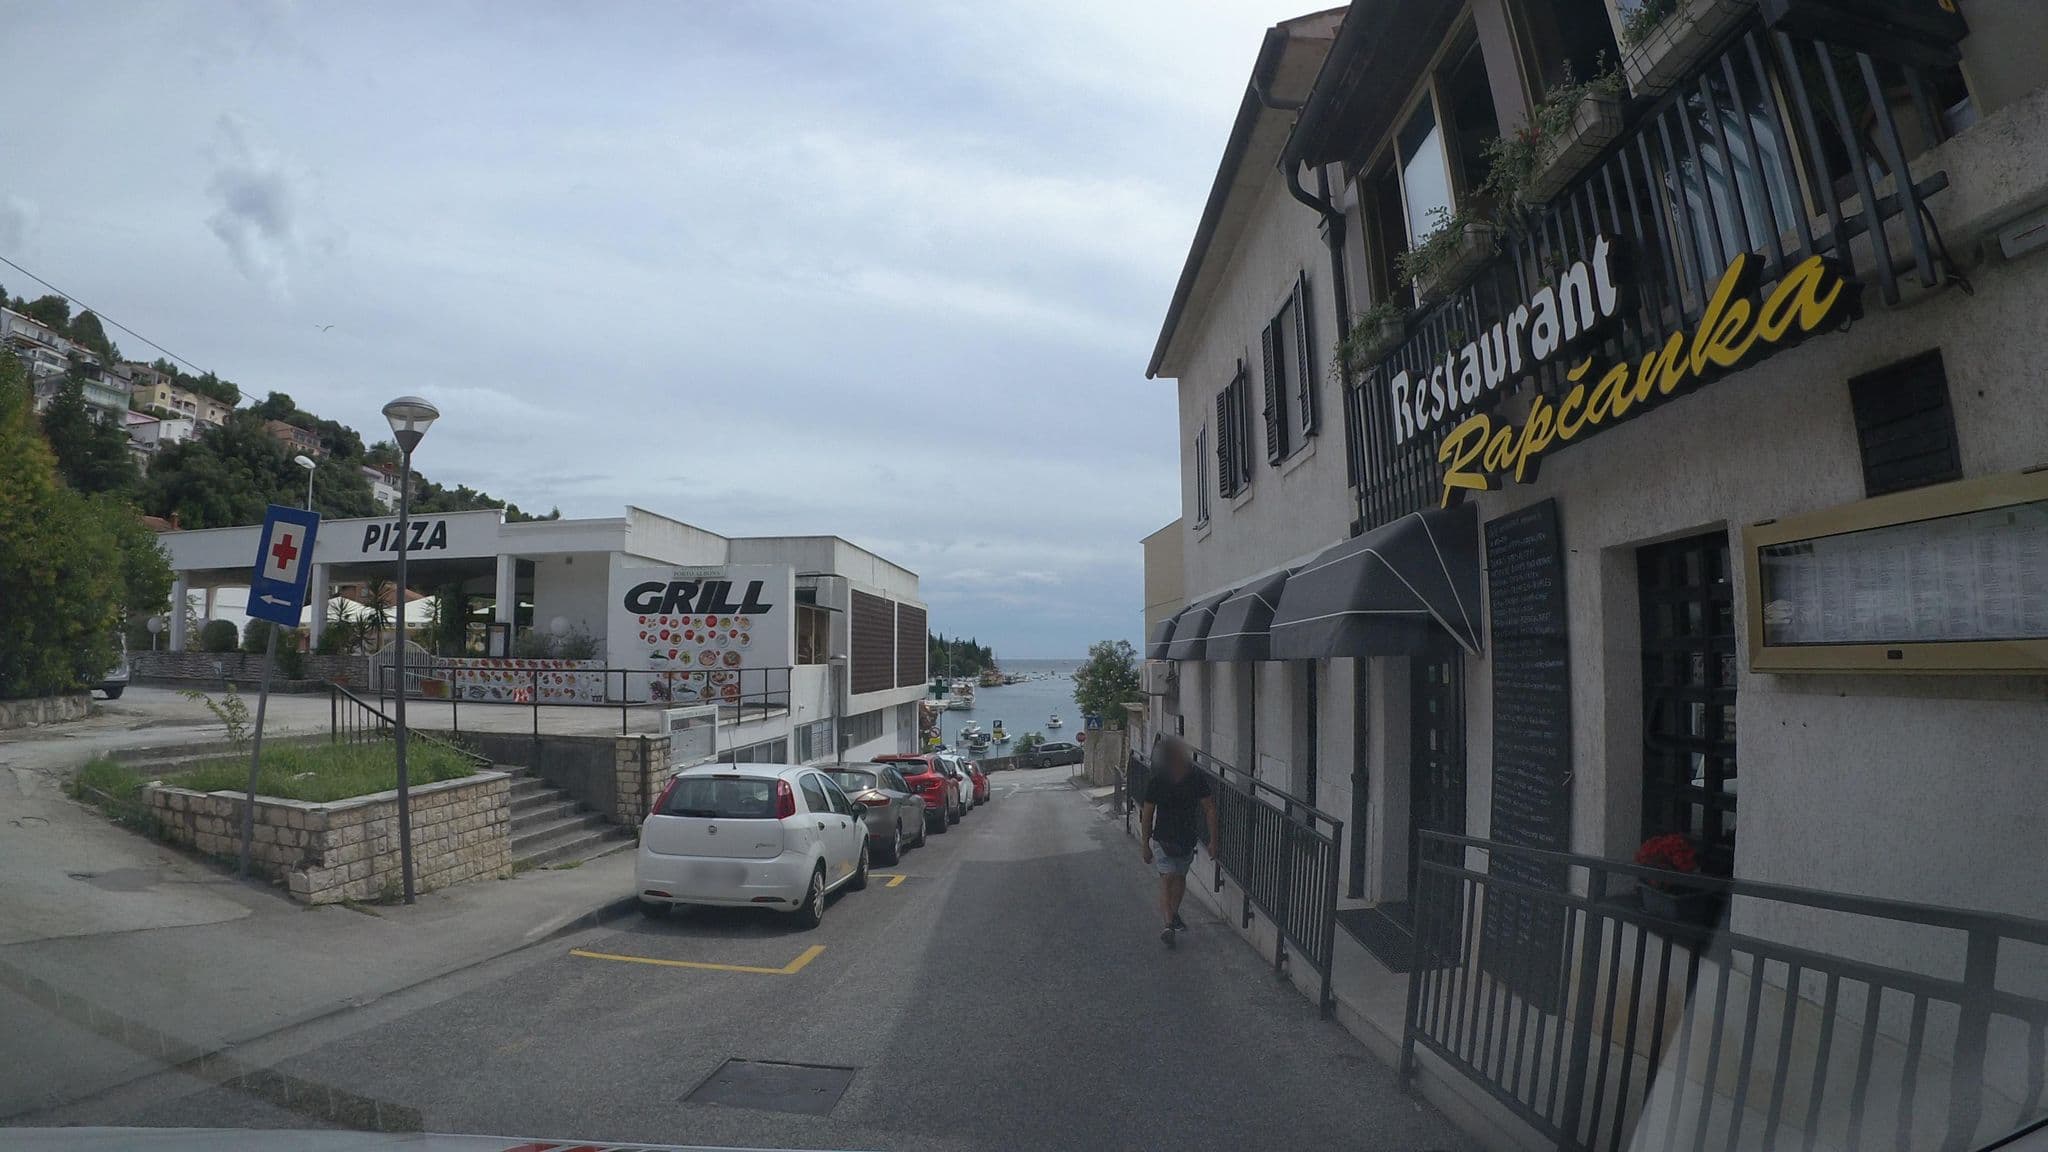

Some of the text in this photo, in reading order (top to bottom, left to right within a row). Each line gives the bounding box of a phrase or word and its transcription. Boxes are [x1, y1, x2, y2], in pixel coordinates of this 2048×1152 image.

[1391, 234, 1617, 445] Restaurant
[1437, 253, 1844, 509] Rapčanka
[362, 520, 447, 553] PIZZA
[623, 580, 774, 615] GRILL
